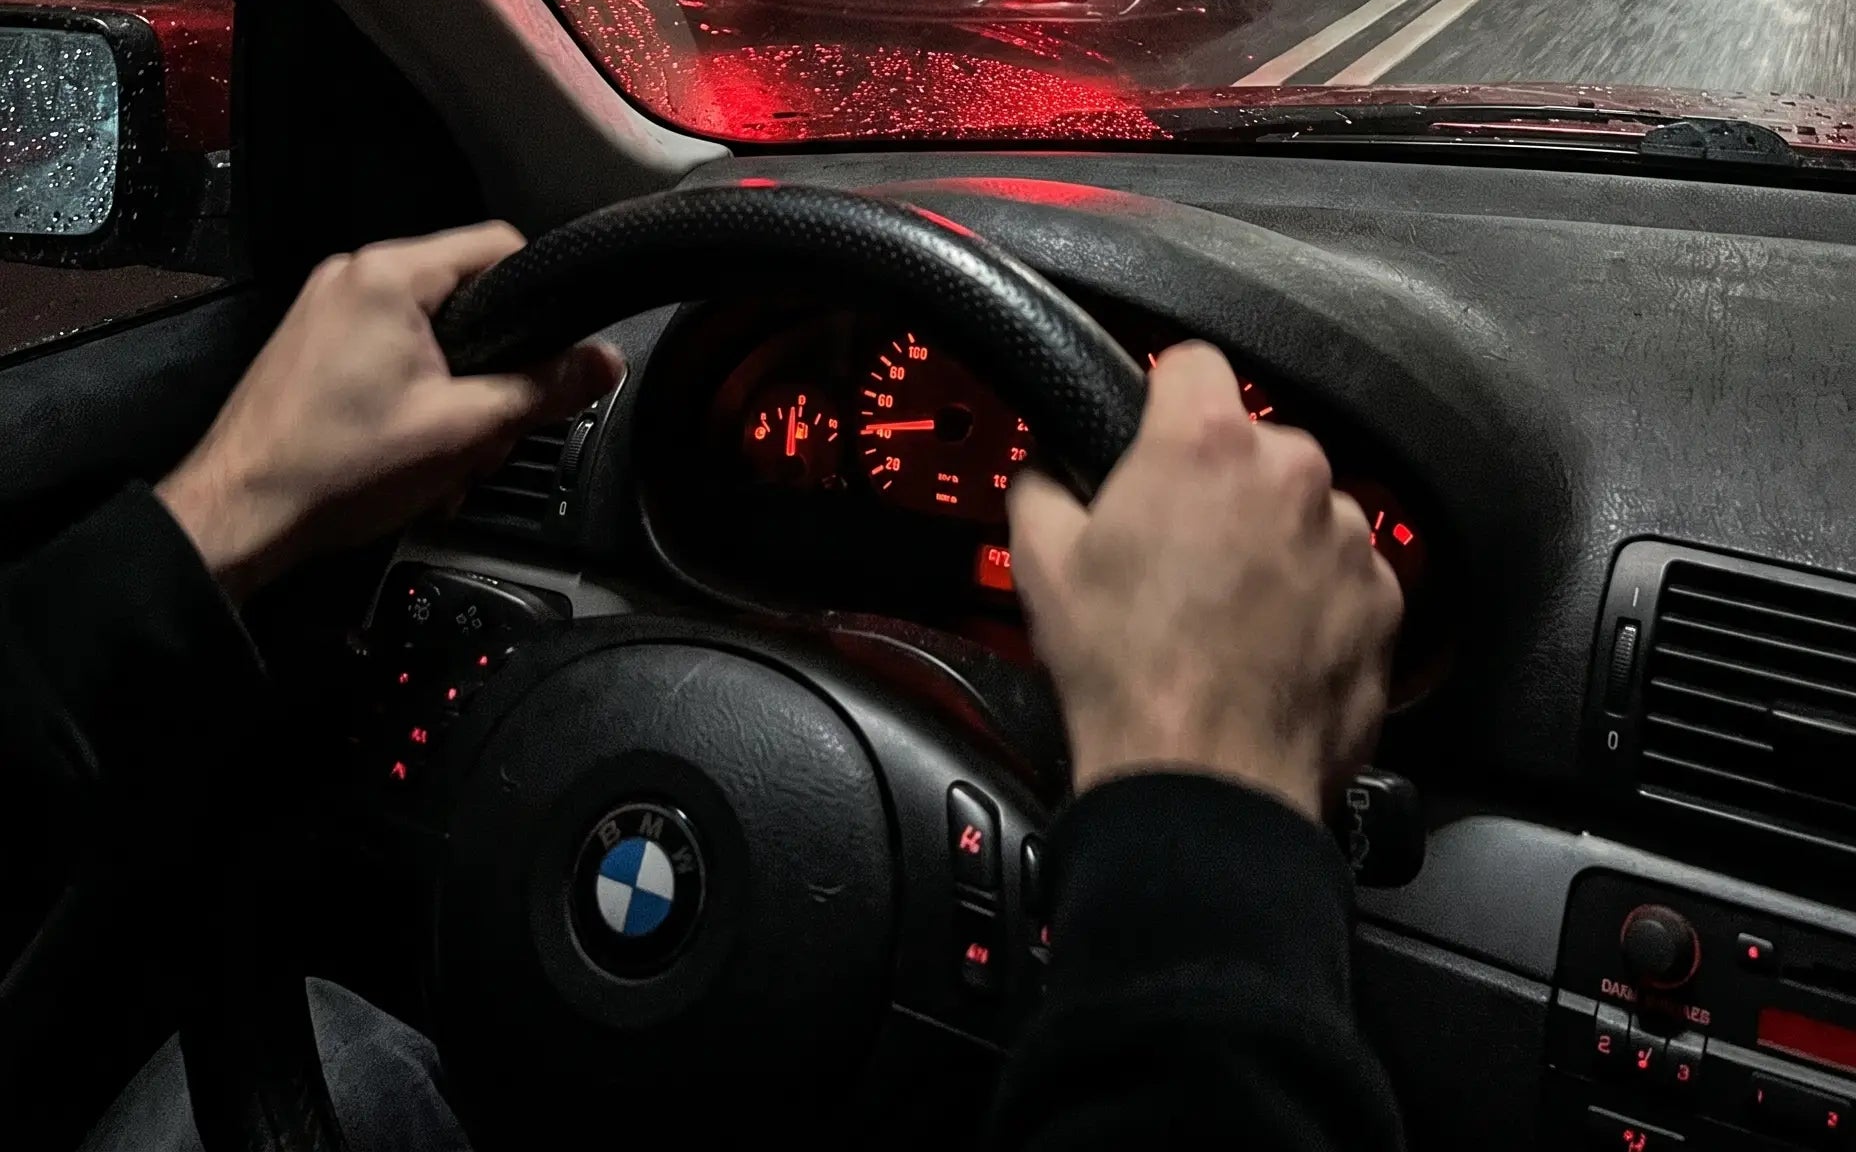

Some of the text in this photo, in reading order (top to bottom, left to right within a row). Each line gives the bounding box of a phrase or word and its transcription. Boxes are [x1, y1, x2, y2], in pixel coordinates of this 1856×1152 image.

[909, 346, 928, 360] 100
[878, 394, 893, 408] 60
[885, 456, 901, 471] 20
[599, 811, 694, 875] BMW
[1597, 1035, 1611, 1055] 2
